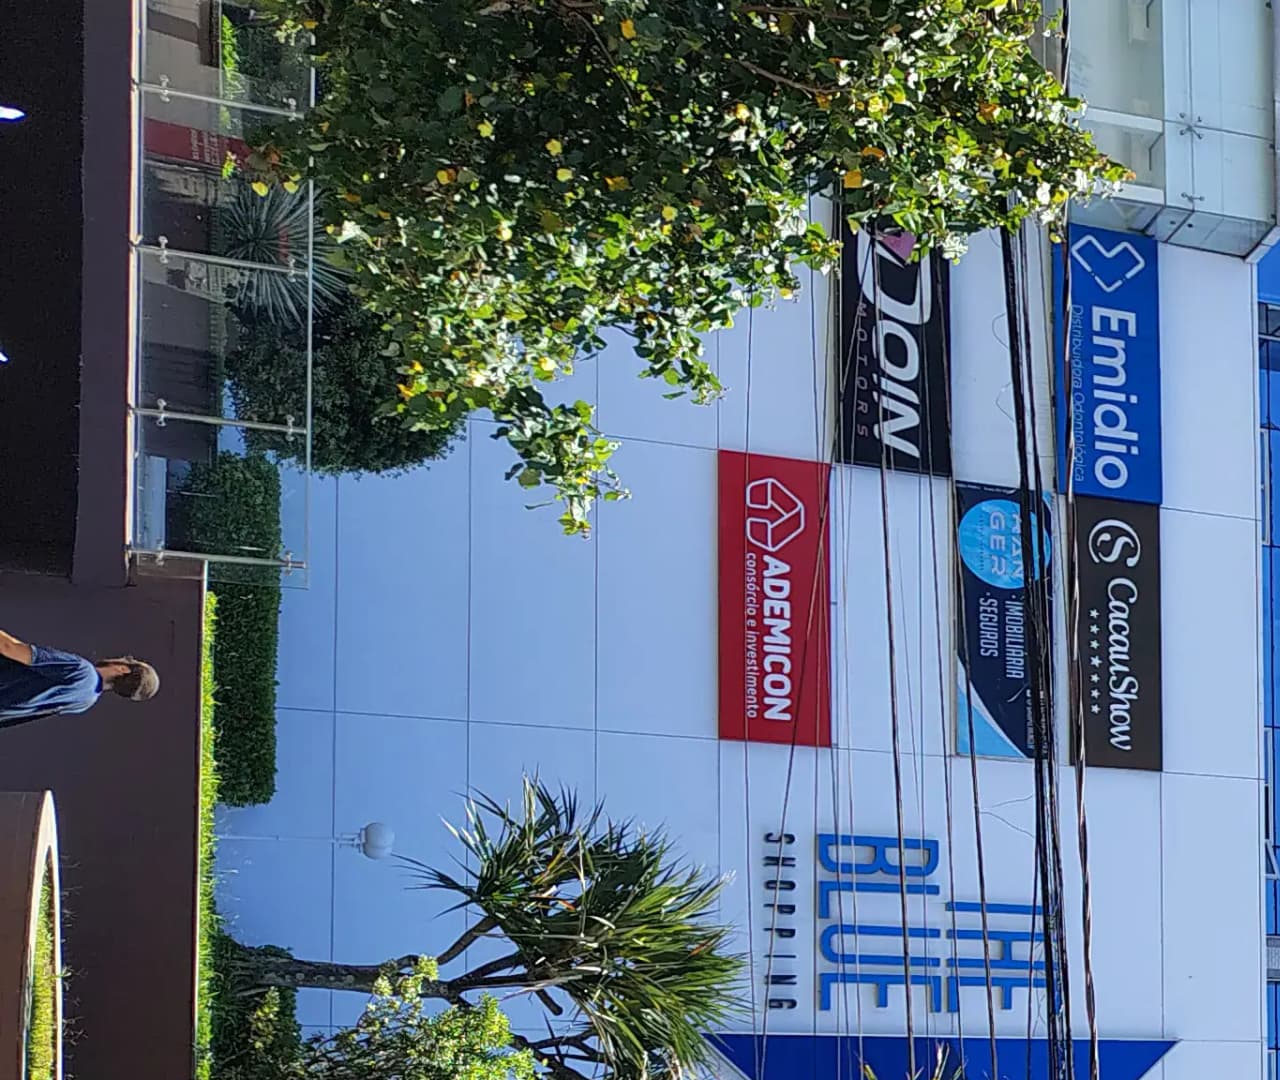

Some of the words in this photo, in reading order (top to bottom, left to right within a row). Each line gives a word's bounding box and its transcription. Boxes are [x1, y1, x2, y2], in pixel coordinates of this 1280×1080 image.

[856, 301, 869, 438] MOTORS
[1072, 304, 1084, 389] Distribuidora
[1091, 305, 1139, 489] Emidio
[746, 552, 760, 615] consórcio
[990, 511, 1006, 575] GER
[746, 619, 757, 627] e
[763, 554, 792, 720] ADEMICON
[980, 597, 997, 656] SEGUROS
[1005, 600, 1027, 679] IMOBILIÁRIA
[746, 630, 760, 718] investimento
[763, 832, 797, 1011] SHOPPING
[817, 833, 942, 1013] BLUE
